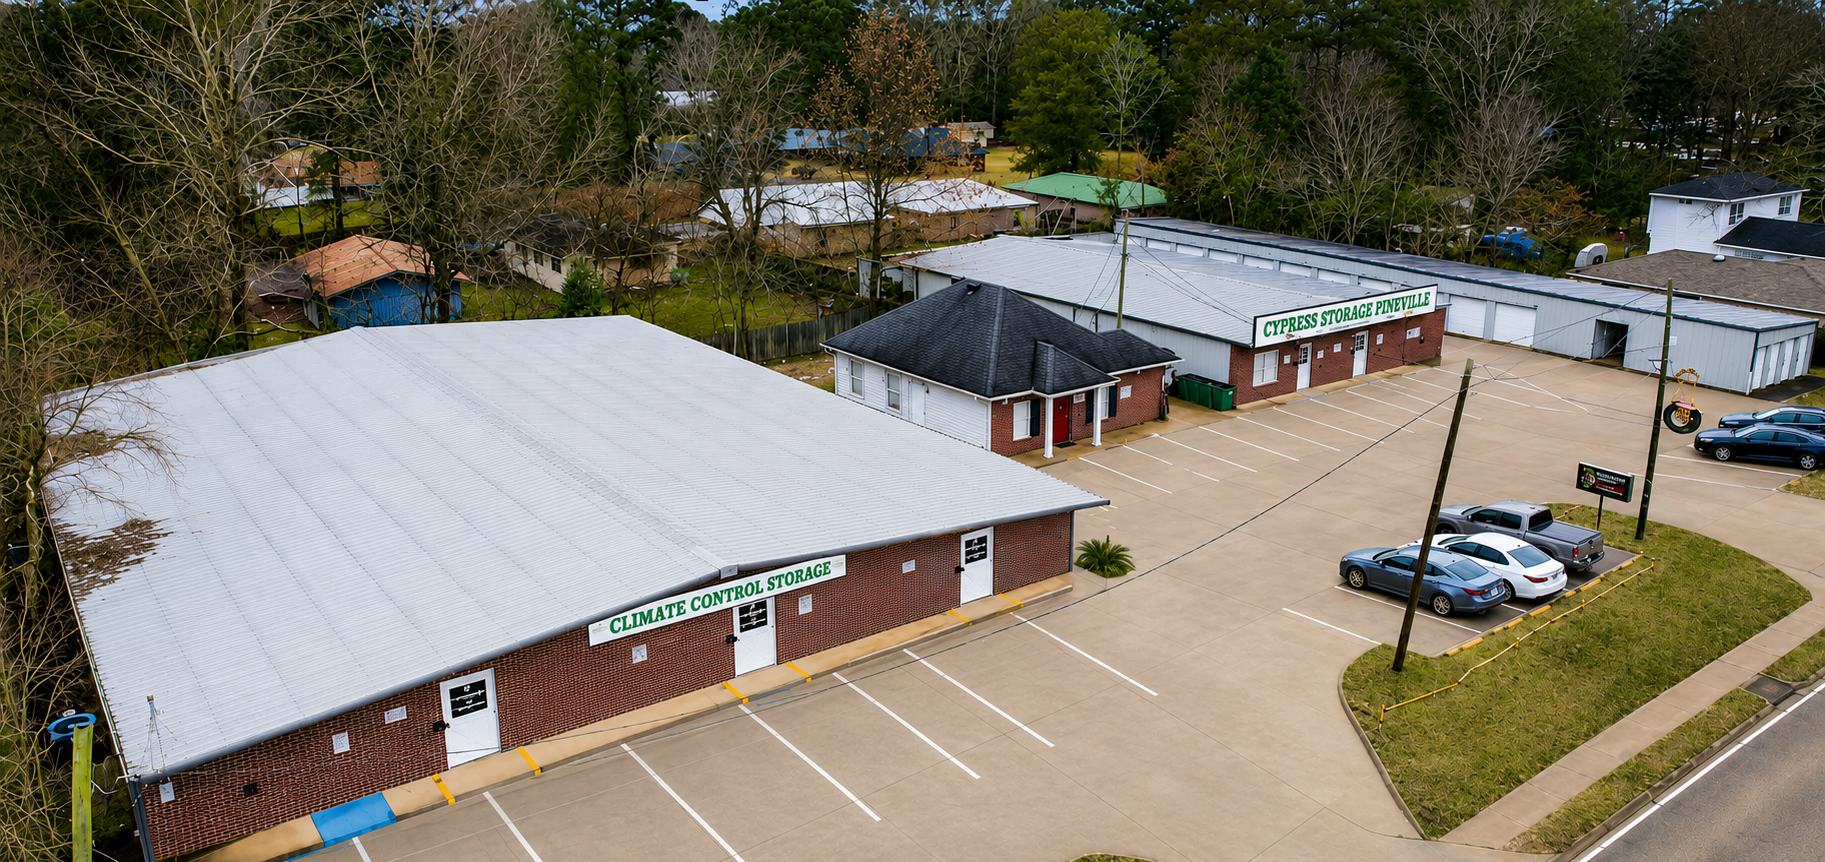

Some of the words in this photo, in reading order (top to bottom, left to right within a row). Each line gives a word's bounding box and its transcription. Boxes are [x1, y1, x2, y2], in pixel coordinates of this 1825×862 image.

[1263, 312, 1318, 338] CYPRESS
[1320, 302, 1373, 328] STORAGE
[1374, 291, 1431, 316] PINEVILLE
[609, 600, 687, 635] CLIMATE
[689, 580, 764, 612] CONTROL
[766, 560, 832, 592] STORAGE
